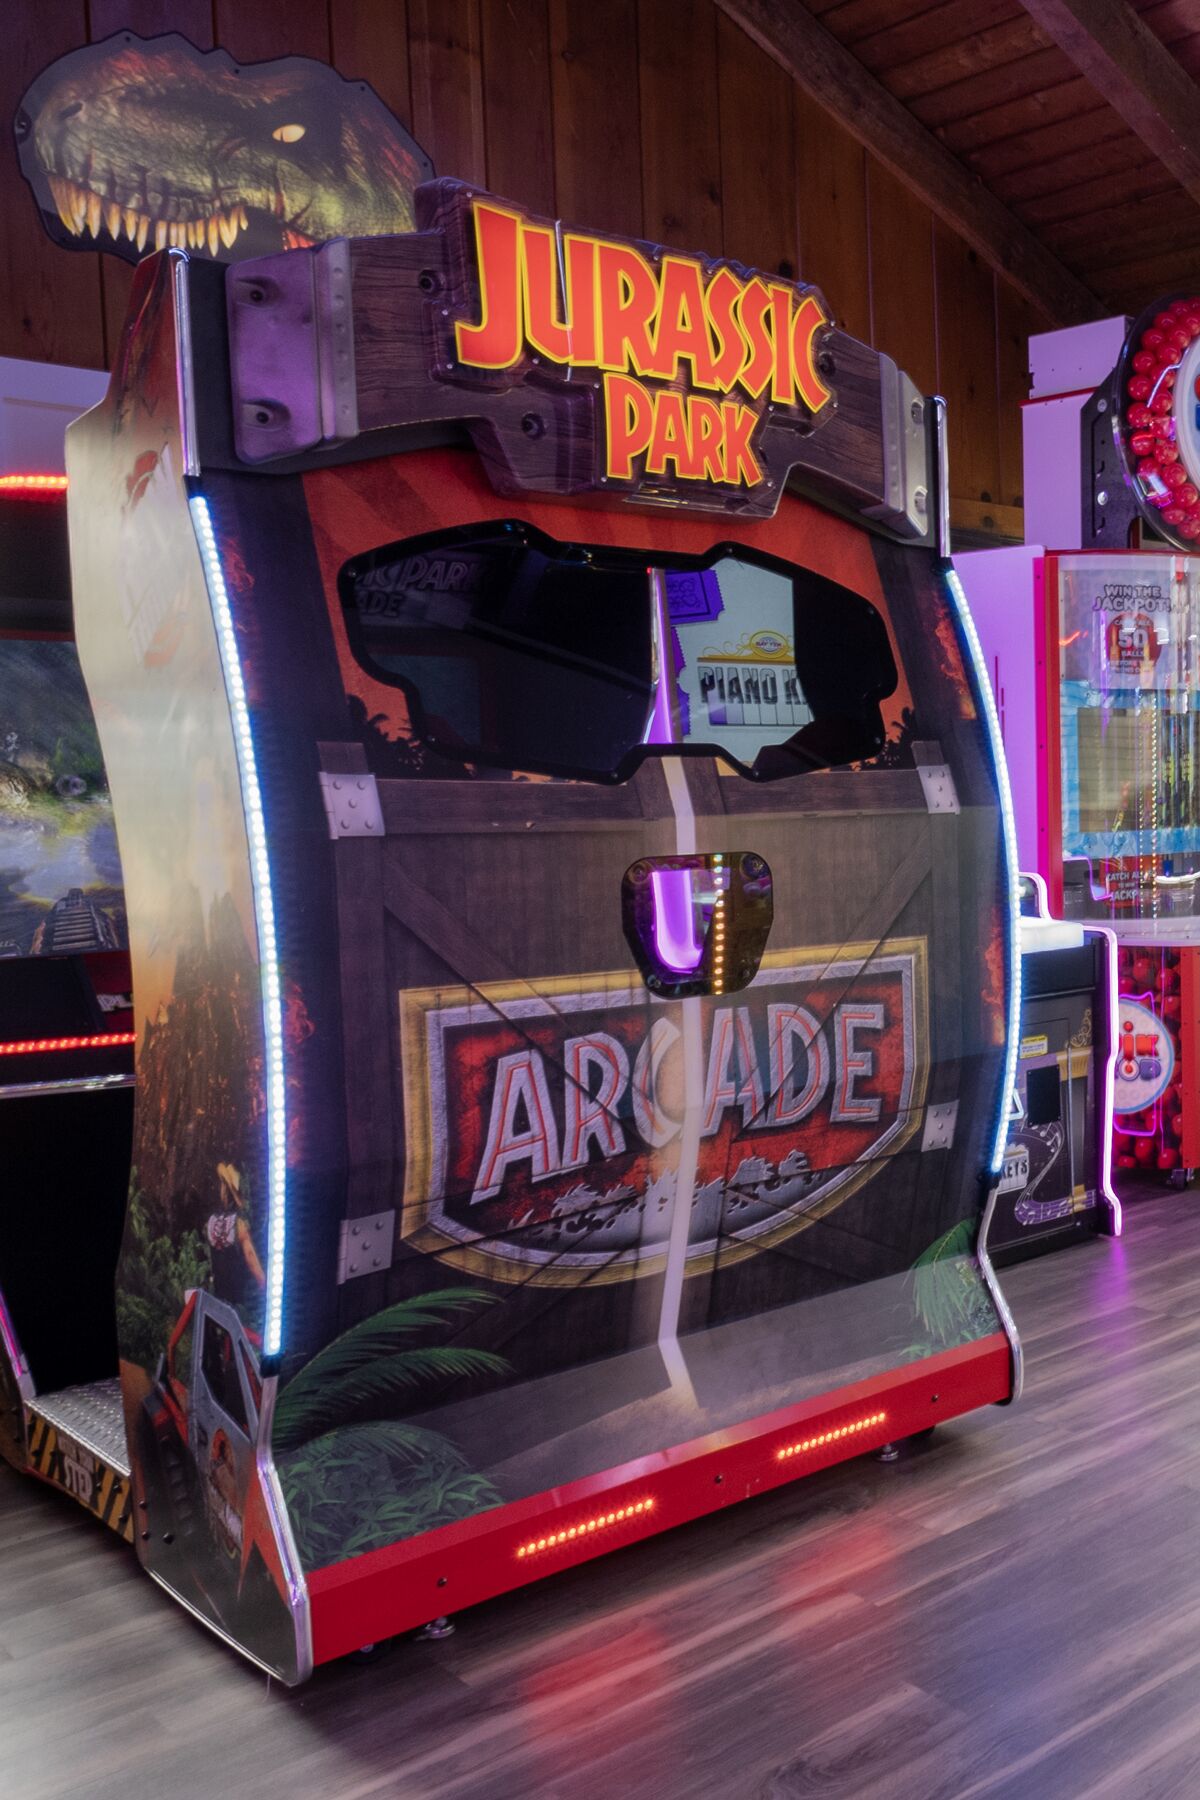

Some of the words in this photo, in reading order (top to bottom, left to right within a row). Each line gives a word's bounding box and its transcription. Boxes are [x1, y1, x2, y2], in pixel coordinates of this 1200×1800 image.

[455, 201, 831, 413] JURASSIC
[603, 371, 763, 487] PARK
[1093, 596, 1171, 611] JACKPOT!
[1103, 584, 1132, 598] WIN
[1135, 585, 1162, 598] THE
[1118, 627, 1149, 649] 50
[698, 666, 778, 704] PIANO
[1107, 872, 1129, 881] CATCH
[470, 1004, 885, 1205] ARCADE
